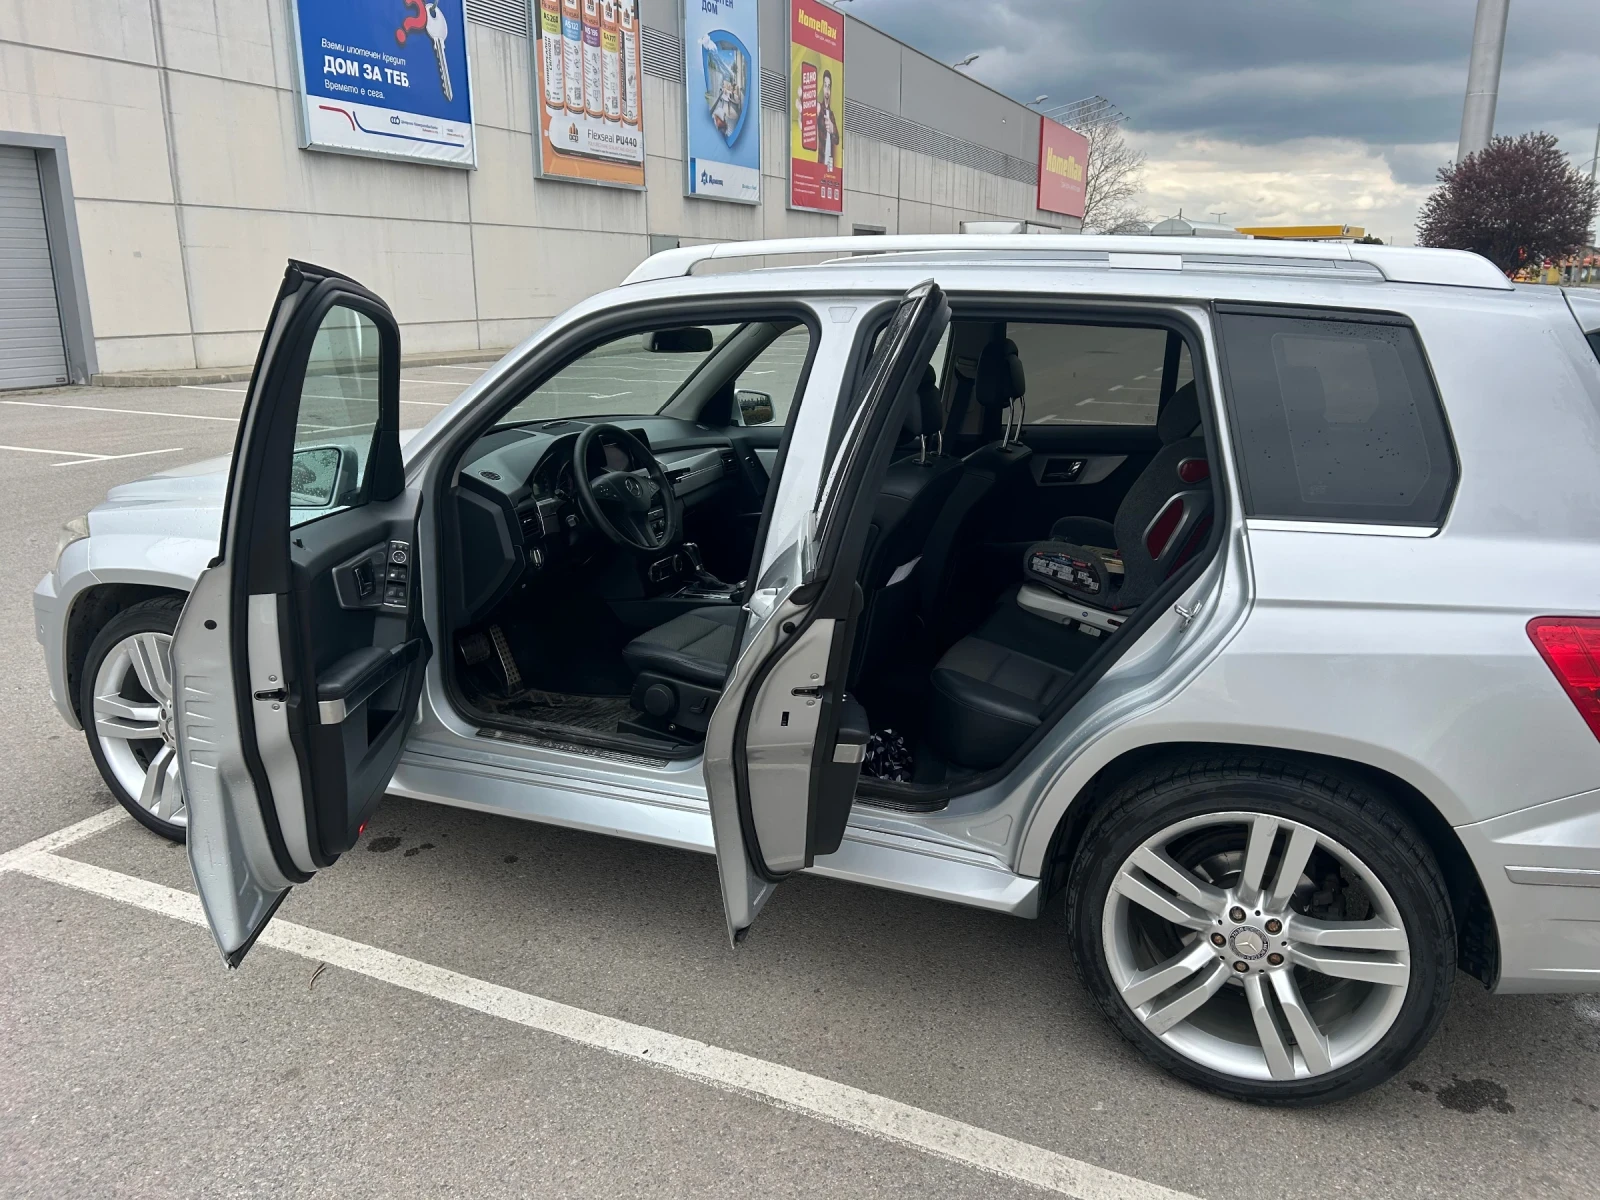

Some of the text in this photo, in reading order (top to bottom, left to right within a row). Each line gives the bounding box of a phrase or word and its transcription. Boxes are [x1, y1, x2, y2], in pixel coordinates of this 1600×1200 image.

[798, 8, 837, 40] HomeMax
[321, 37, 406, 66] Вземи ипотечен кредит
[323, 55, 359, 77] ДОМ
[362, 63, 383, 82] ЗА
[324, 78, 359, 94] Времето
[360, 87, 366, 96] е
[587, 128, 615, 143] Flexseal
[615, 135, 638, 148] PU440
[1046, 146, 1083, 182] HomeMax
